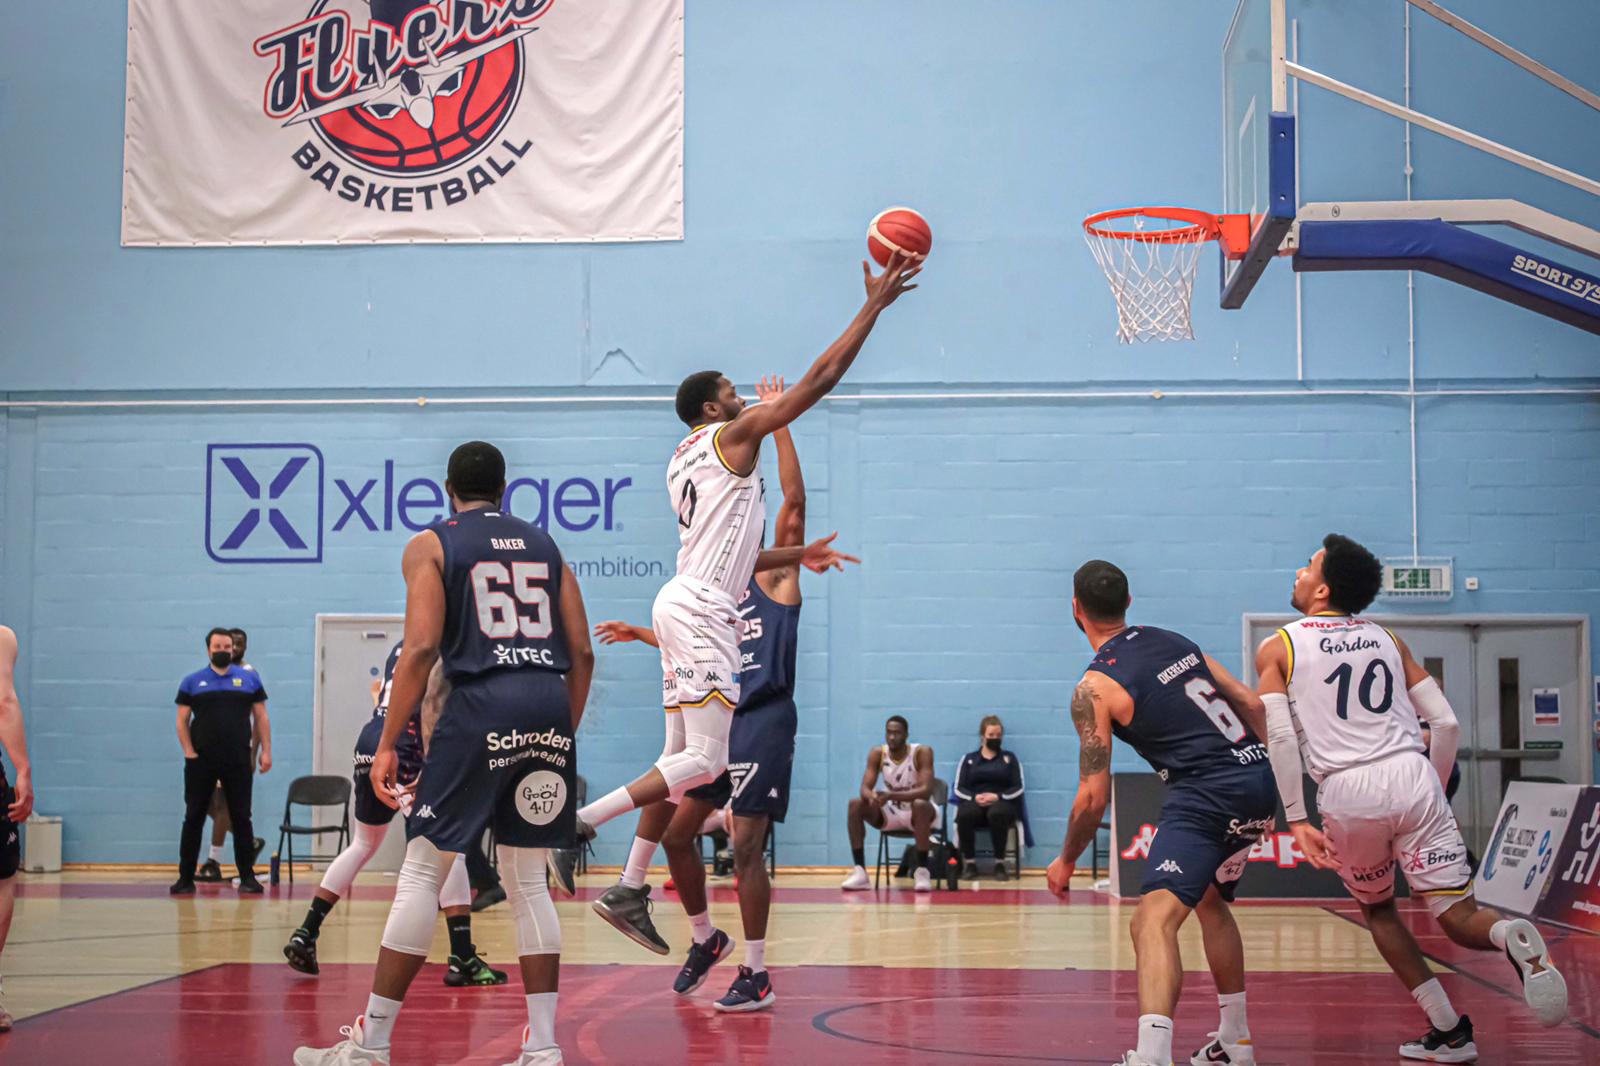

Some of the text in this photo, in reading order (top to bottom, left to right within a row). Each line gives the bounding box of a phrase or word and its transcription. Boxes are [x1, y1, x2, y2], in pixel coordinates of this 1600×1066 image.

[291, 140, 533, 212] BASKETBALL
[331, 460, 632, 533] xleger
[491, 538, 526, 550] BAKER
[471, 561, 553, 639] 65
[1301, 621, 1344, 629] Wirr
[1320, 637, 1381, 655] Gordon
[1157, 652, 1200, 685] OKEREAFOR
[1324, 658, 1394, 720] 10
[1184, 677, 1247, 743] 6
[486, 728, 572, 751] Schroders
[489, 748, 533, 770] peral
[523, 782, 559, 801] Good
[1427, 850, 1457, 866] Brio
